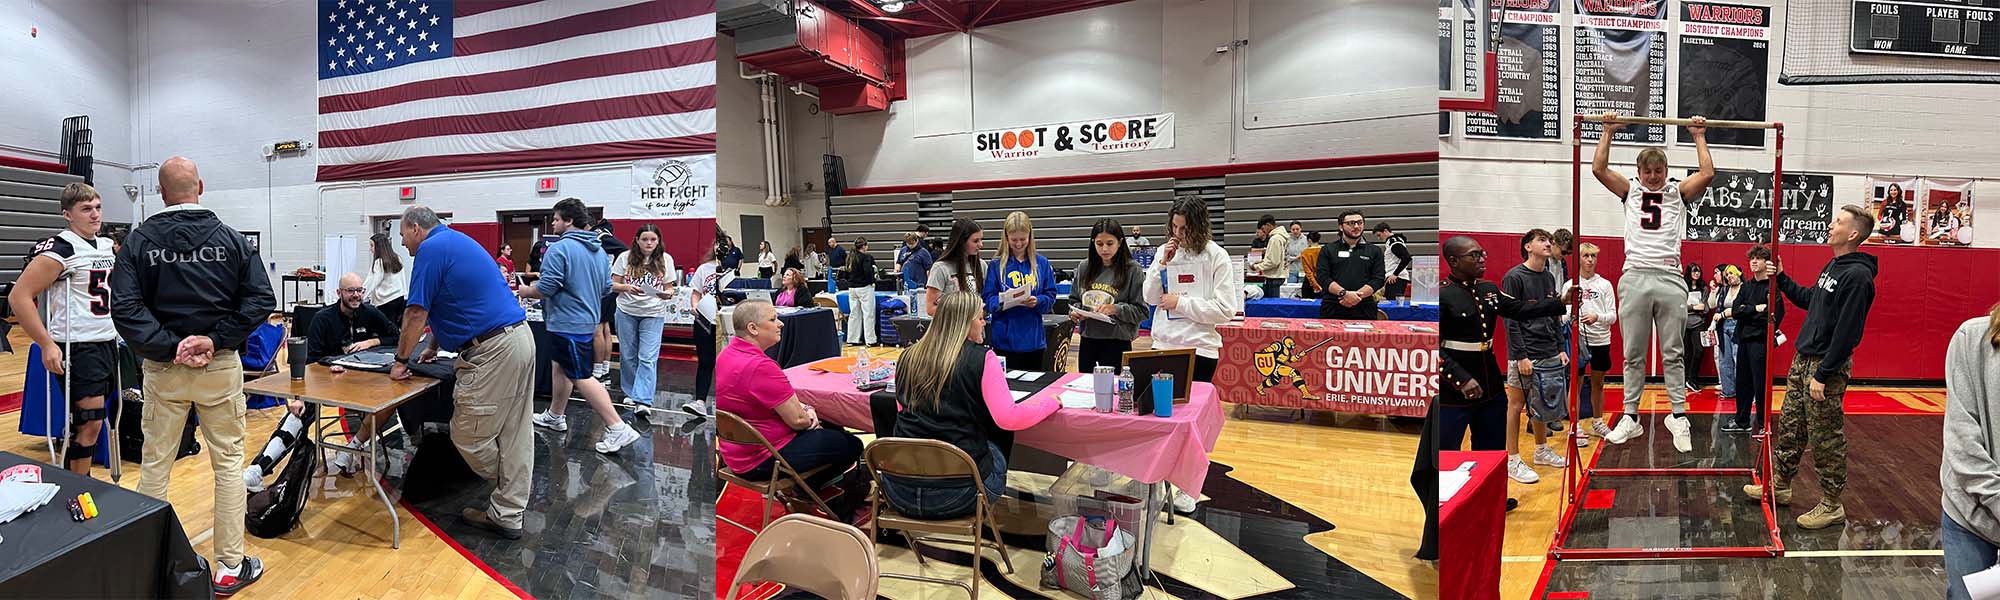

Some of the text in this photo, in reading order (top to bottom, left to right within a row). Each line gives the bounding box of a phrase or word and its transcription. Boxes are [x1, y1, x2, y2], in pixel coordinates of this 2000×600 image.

[1688, 4, 1762, 25] WARRIORS
[1870, 4, 1899, 14] FOULS
[1926, 8, 1994, 21] PLAYER FOULS
[1507, 12, 1553, 22] CHAMPIONS
[1580, 17, 1662, 29] DISTRICT CHAMPIONS
[1576, 30, 1605, 38] SOFTBALL
[1685, 24, 1764, 37] DISTRICT CHAMPIONS
[1576, 38, 1605, 46] SOFTBALL
[1874, 40, 1892, 50] WON
[1944, 44, 1968, 54] GAME
[1502, 72, 1530, 80] COUNTRY
[1467, 118, 1498, 126] FOOTBALL
[1054, 125, 1074, 152] &
[1079, 117, 1157, 145] SCORE
[1467, 126, 1498, 134] SOFTBALL
[1615, 132, 1635, 140] SPIRIT
[1091, 140, 1151, 151] Territory
[990, 149, 1039, 159] Warrior
[641, 187, 665, 199] HER
[673, 199, 698, 211] fight
[1640, 191, 1664, 231] 5
[1690, 215, 1712, 226] one
[1756, 218, 1772, 229] on
[34, 237, 56, 255] 56
[146, 246, 228, 267] POLICE
[89, 270, 111, 316] 5
[1257, 356, 1273, 368] GU
[1351, 395, 1426, 408] PENNSYLVANIA
